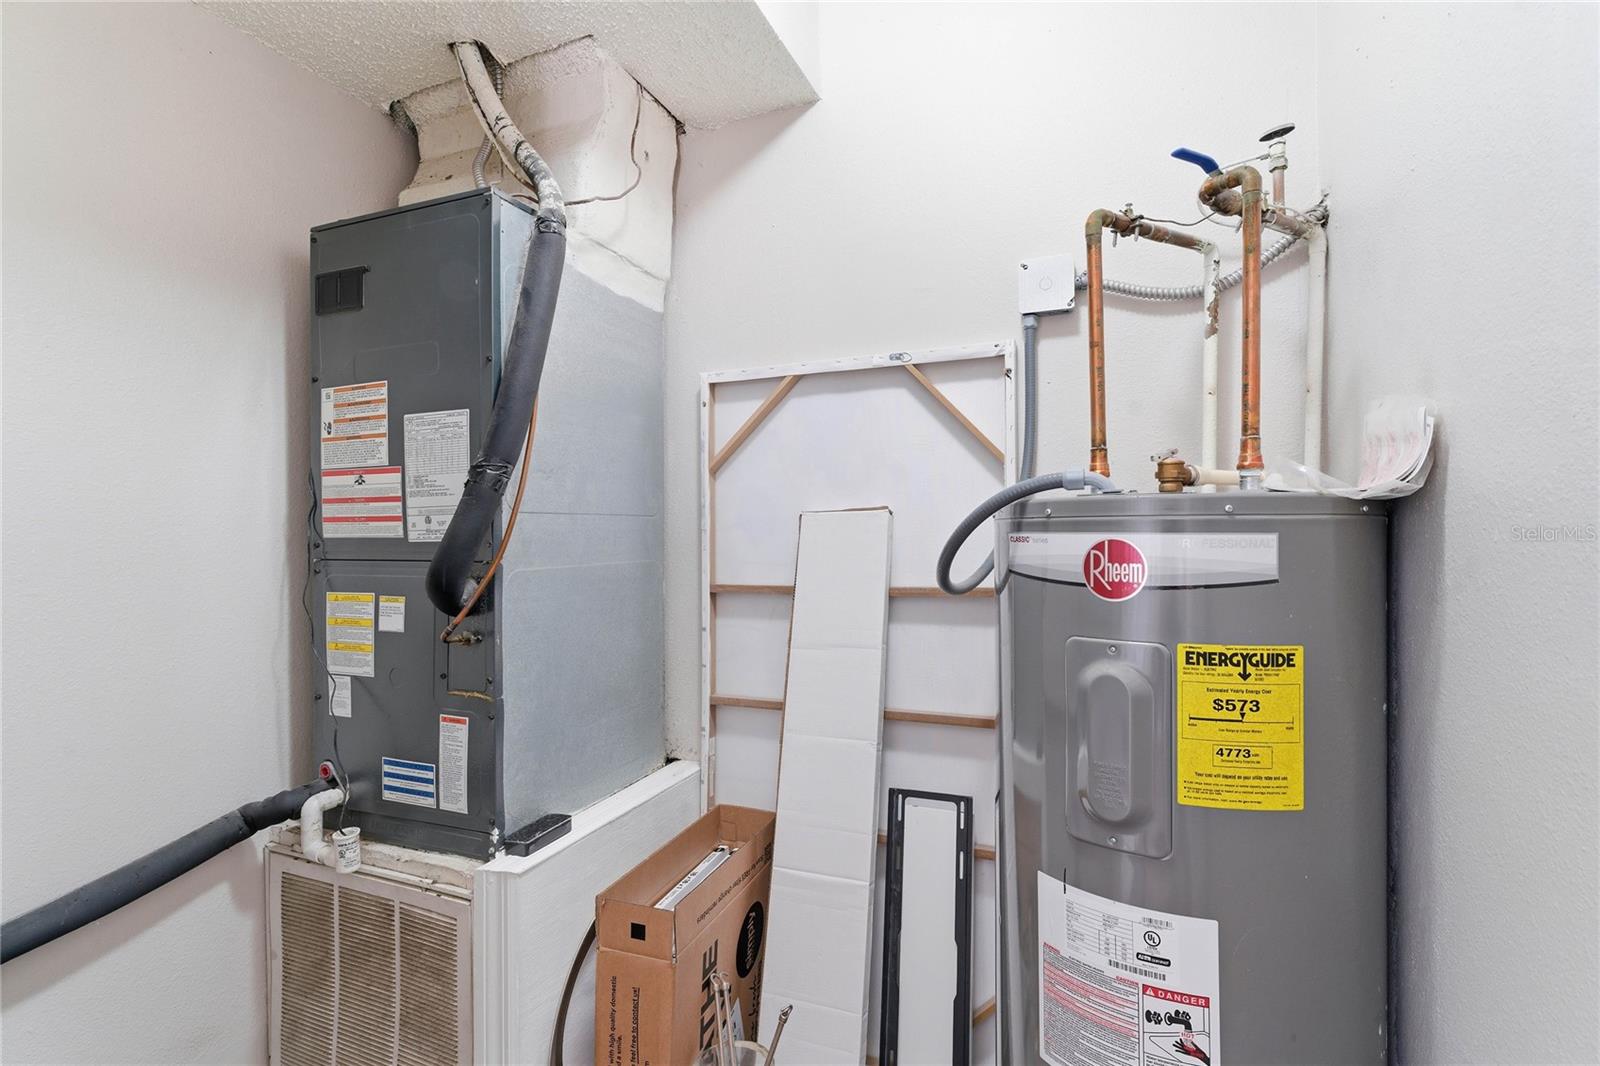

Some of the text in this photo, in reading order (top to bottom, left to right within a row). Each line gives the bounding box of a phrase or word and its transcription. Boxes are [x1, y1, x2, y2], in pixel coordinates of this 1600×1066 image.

[1009, 535, 1030, 544] CLASSIC
[1089, 540, 1144, 591] Rheem
[1185, 650, 1296, 668] ENERGYGUIDE
[1212, 698, 1261, 713] $573
[1215, 747, 1251, 759] 4773
[609, 975, 617, 1007] domestic
[1158, 991, 1206, 1007] DANGER
[609, 1007, 617, 1032] quality
[608, 1033, 616, 1049] high
